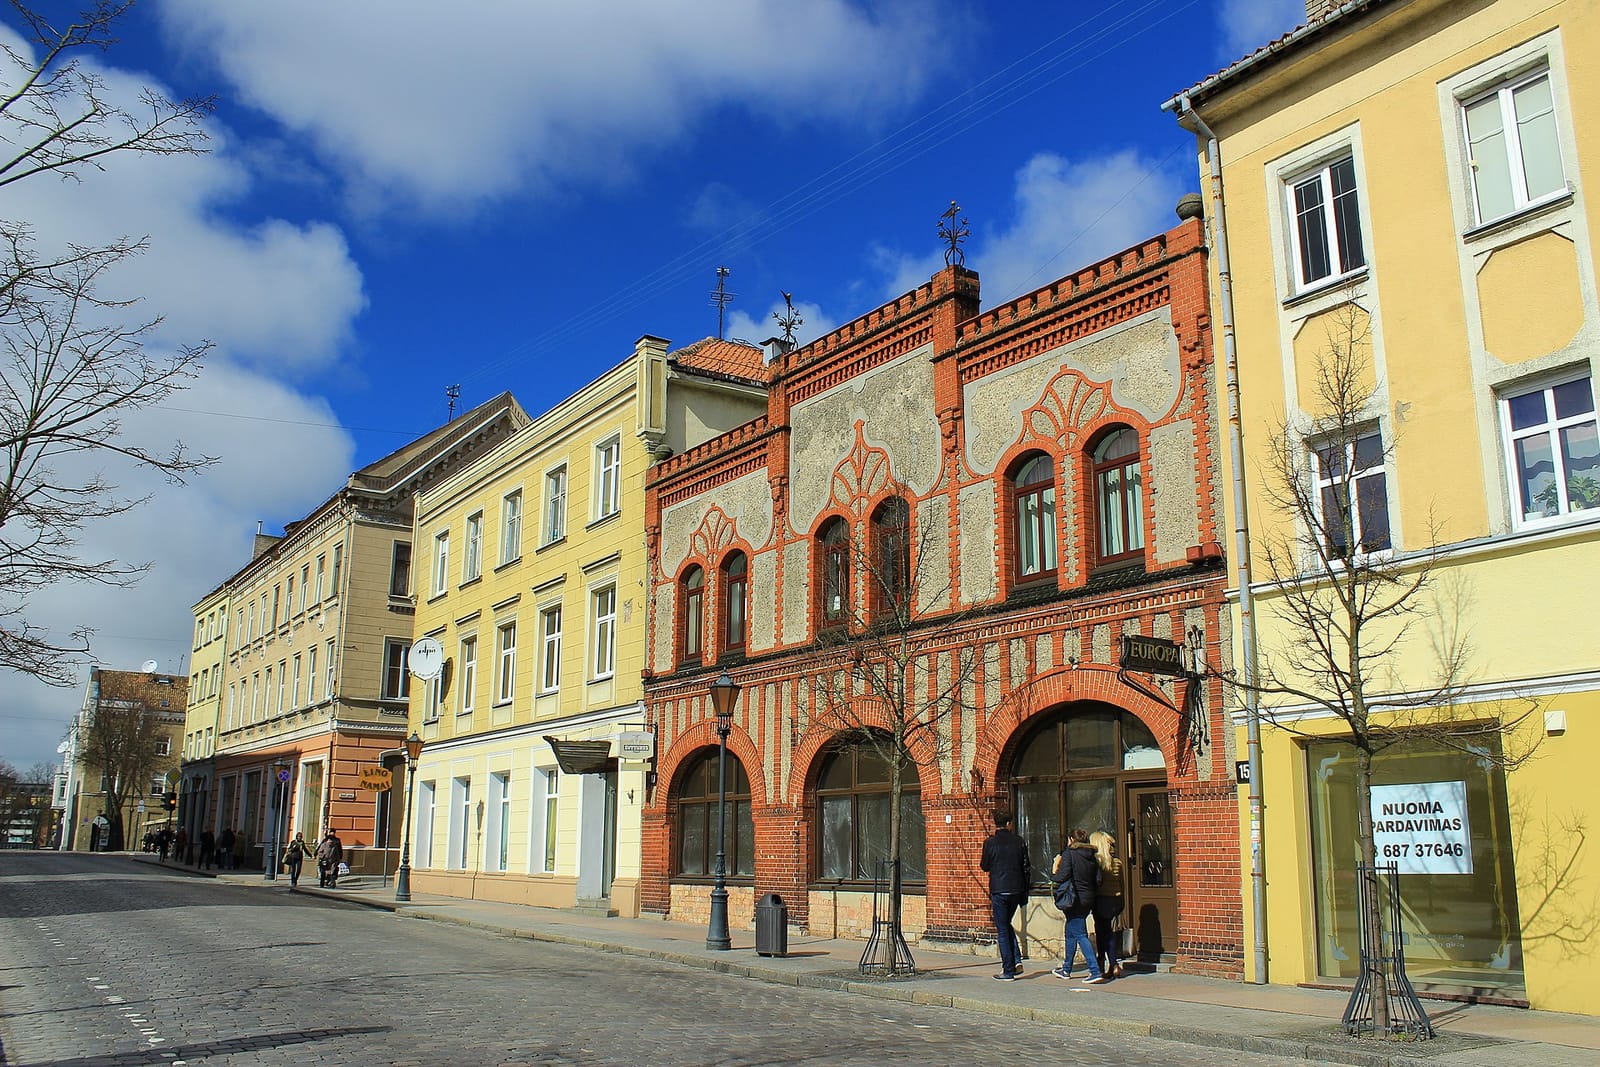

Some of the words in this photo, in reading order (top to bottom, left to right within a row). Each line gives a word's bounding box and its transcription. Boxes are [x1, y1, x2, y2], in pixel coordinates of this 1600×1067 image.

[1130, 641, 1179, 663] EUROPA
[1238, 764, 1250, 779] 15
[1382, 801, 1444, 816] NUOMA
[1383, 844, 1410, 858] 687
[1415, 843, 1463, 858] 37646
